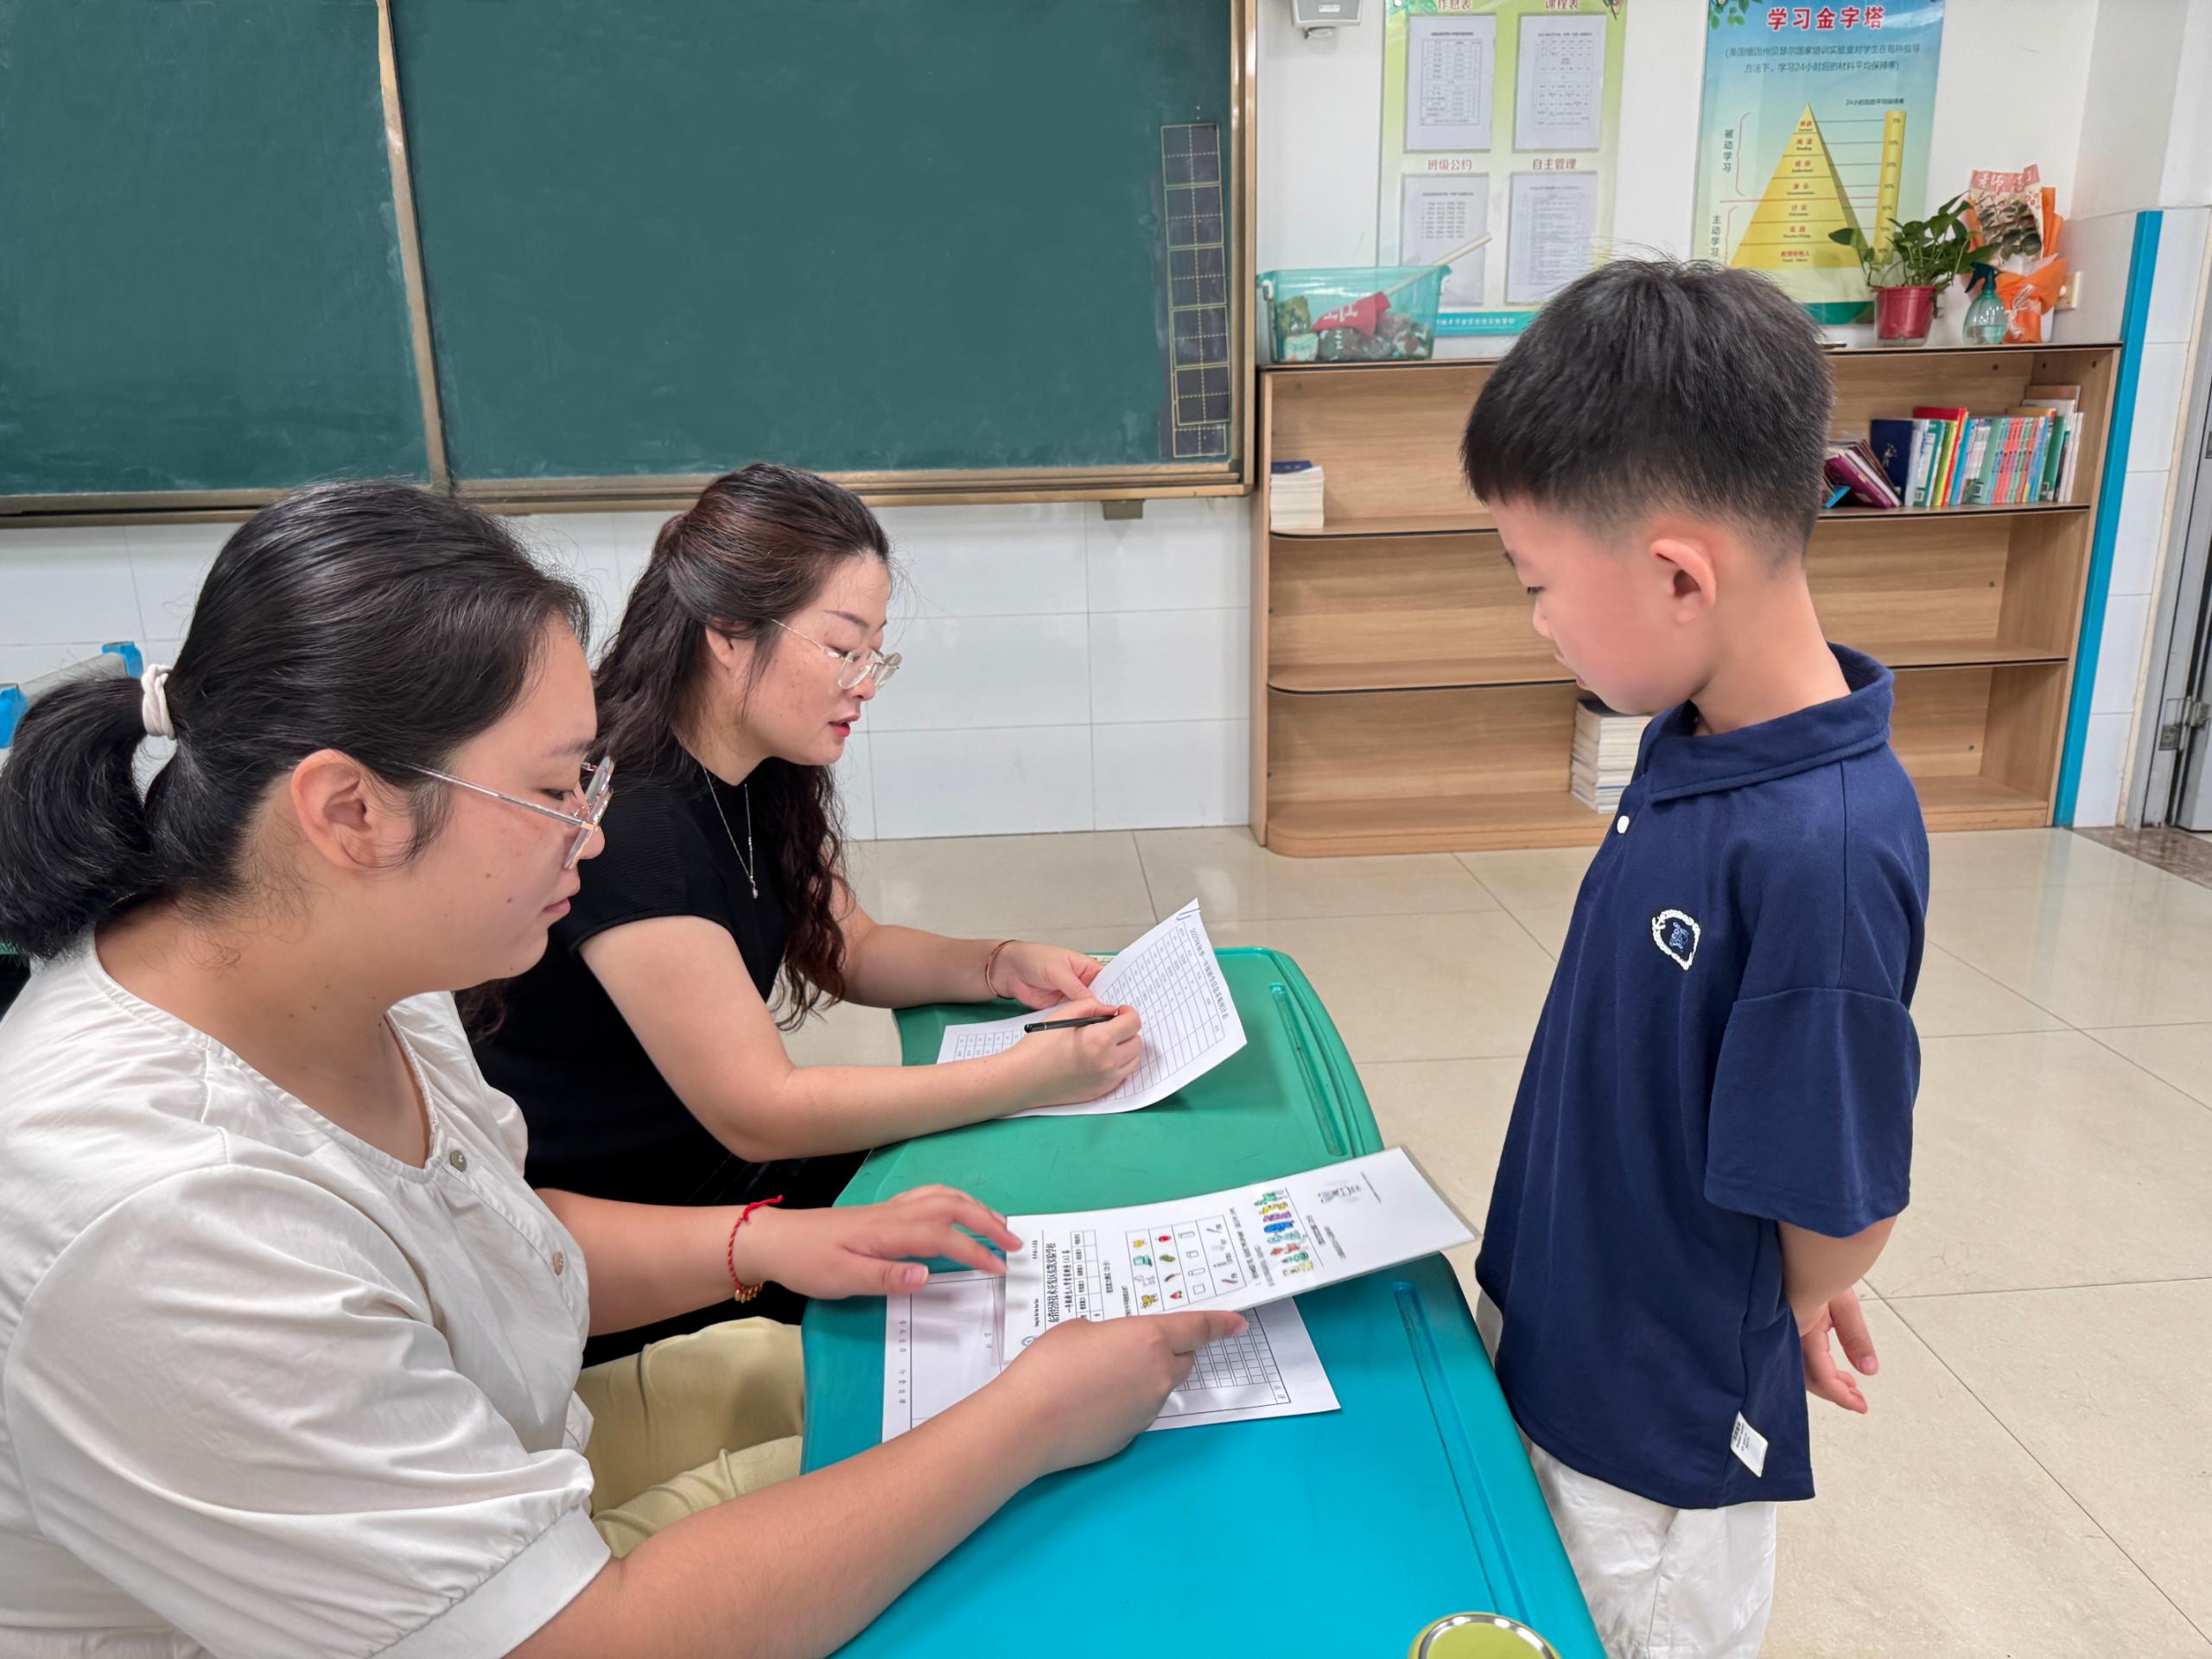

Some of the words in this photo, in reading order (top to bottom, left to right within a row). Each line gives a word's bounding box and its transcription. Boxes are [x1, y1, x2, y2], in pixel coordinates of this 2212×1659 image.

[1768, 7, 1885, 30] 学习金字塔
[1427, 159, 1472, 171] 班级公约
[1532, 158, 1577, 170] 自主管理
